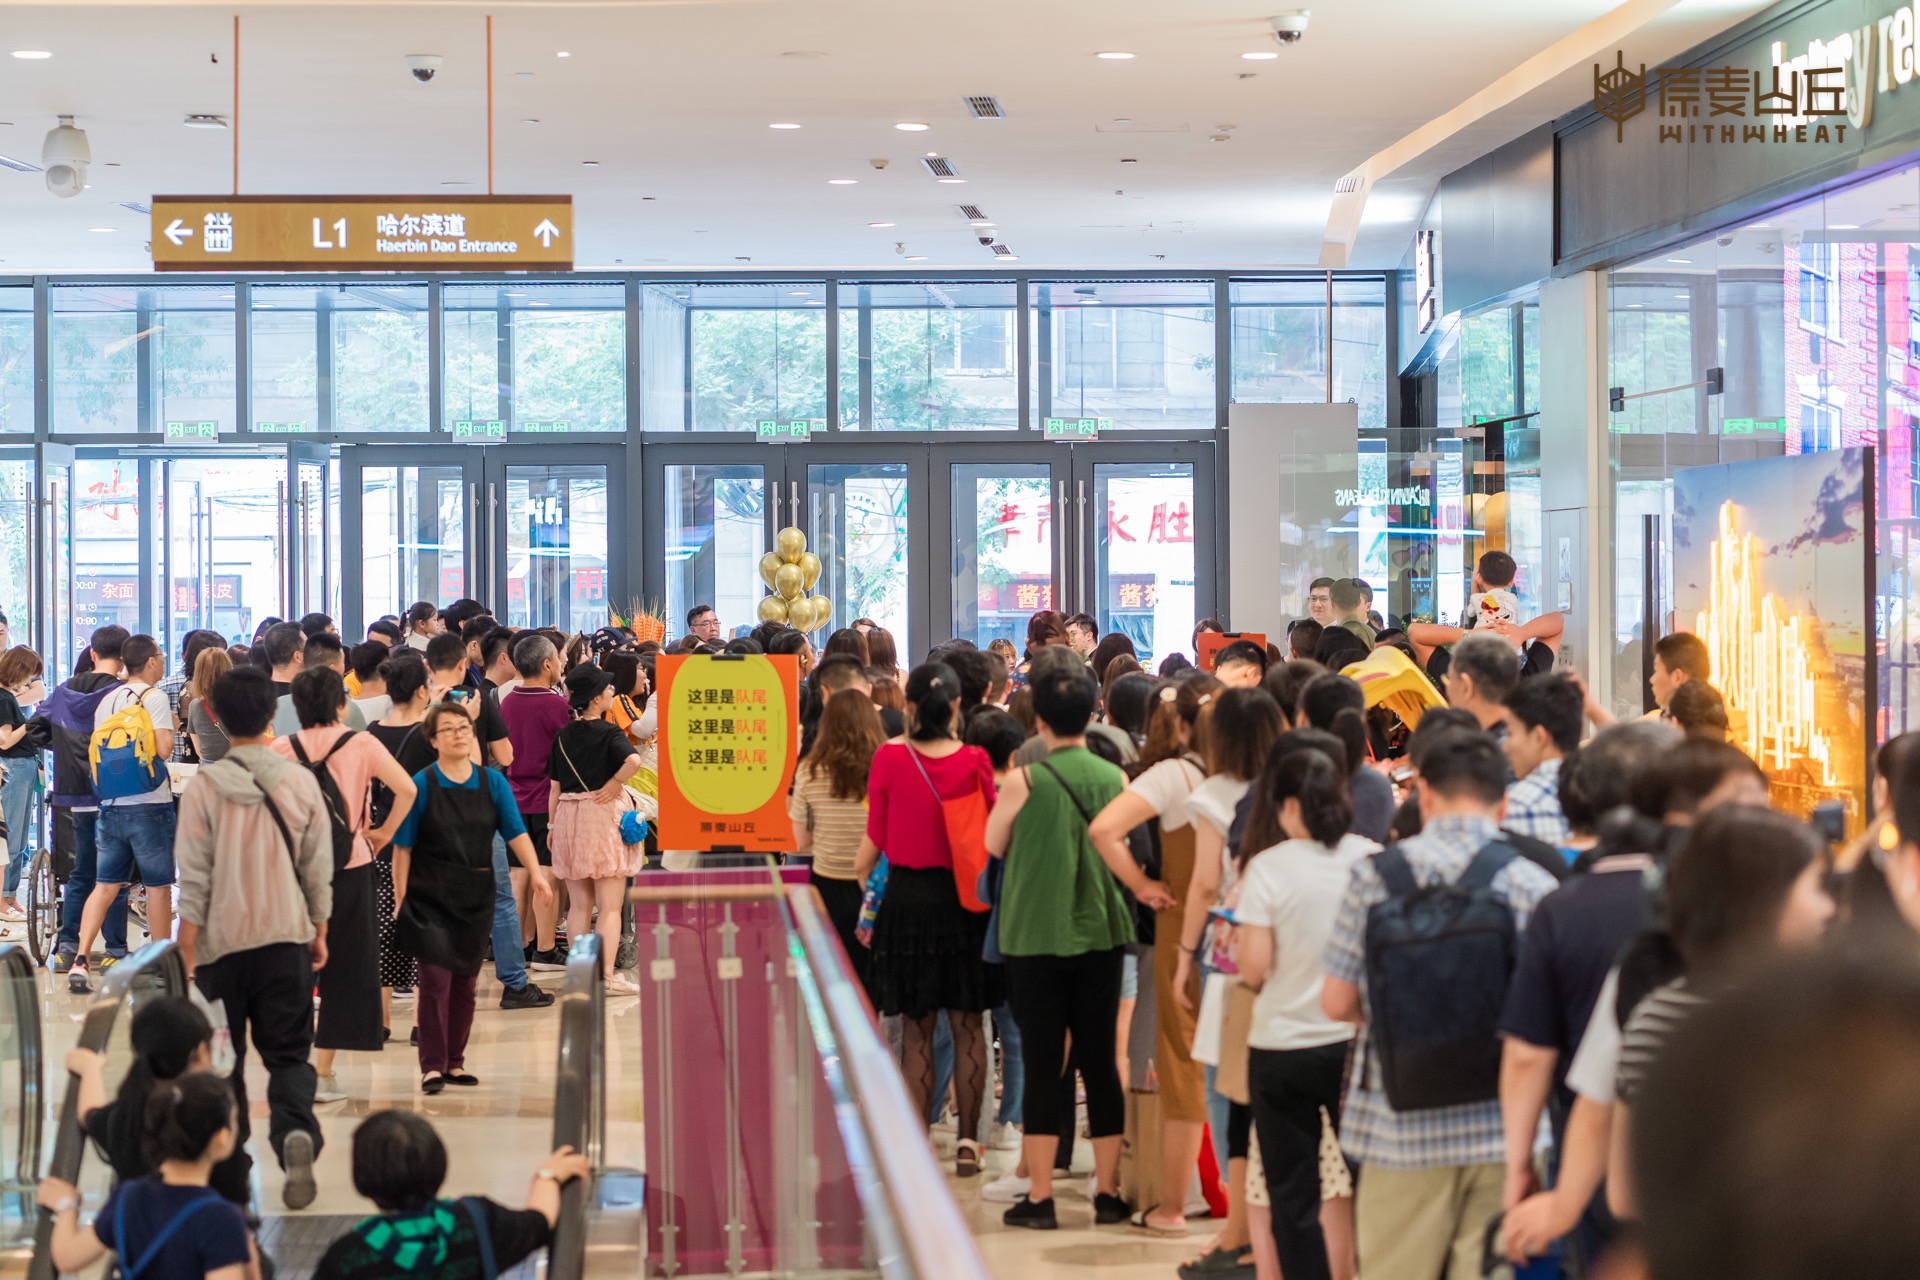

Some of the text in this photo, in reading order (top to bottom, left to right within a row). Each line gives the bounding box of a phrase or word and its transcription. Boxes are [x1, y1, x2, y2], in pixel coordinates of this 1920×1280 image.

[376, 212, 466, 237] 哈尔滨道
[312, 217, 347, 248] L1
[376, 239, 518, 253] Haerbin Dao Entrance
[184, 426, 196, 434] EXIT
[473, 425, 485, 433] EXIT
[777, 424, 789, 432] EXIT
[1064, 422, 1078, 430] EXIT
[102, 582, 134, 599] 杂面
[687, 689, 767, 704] 这里是队尾
[687, 719, 767, 734] 这里是队尾
[687, 749, 767, 764] 这里是队尾
